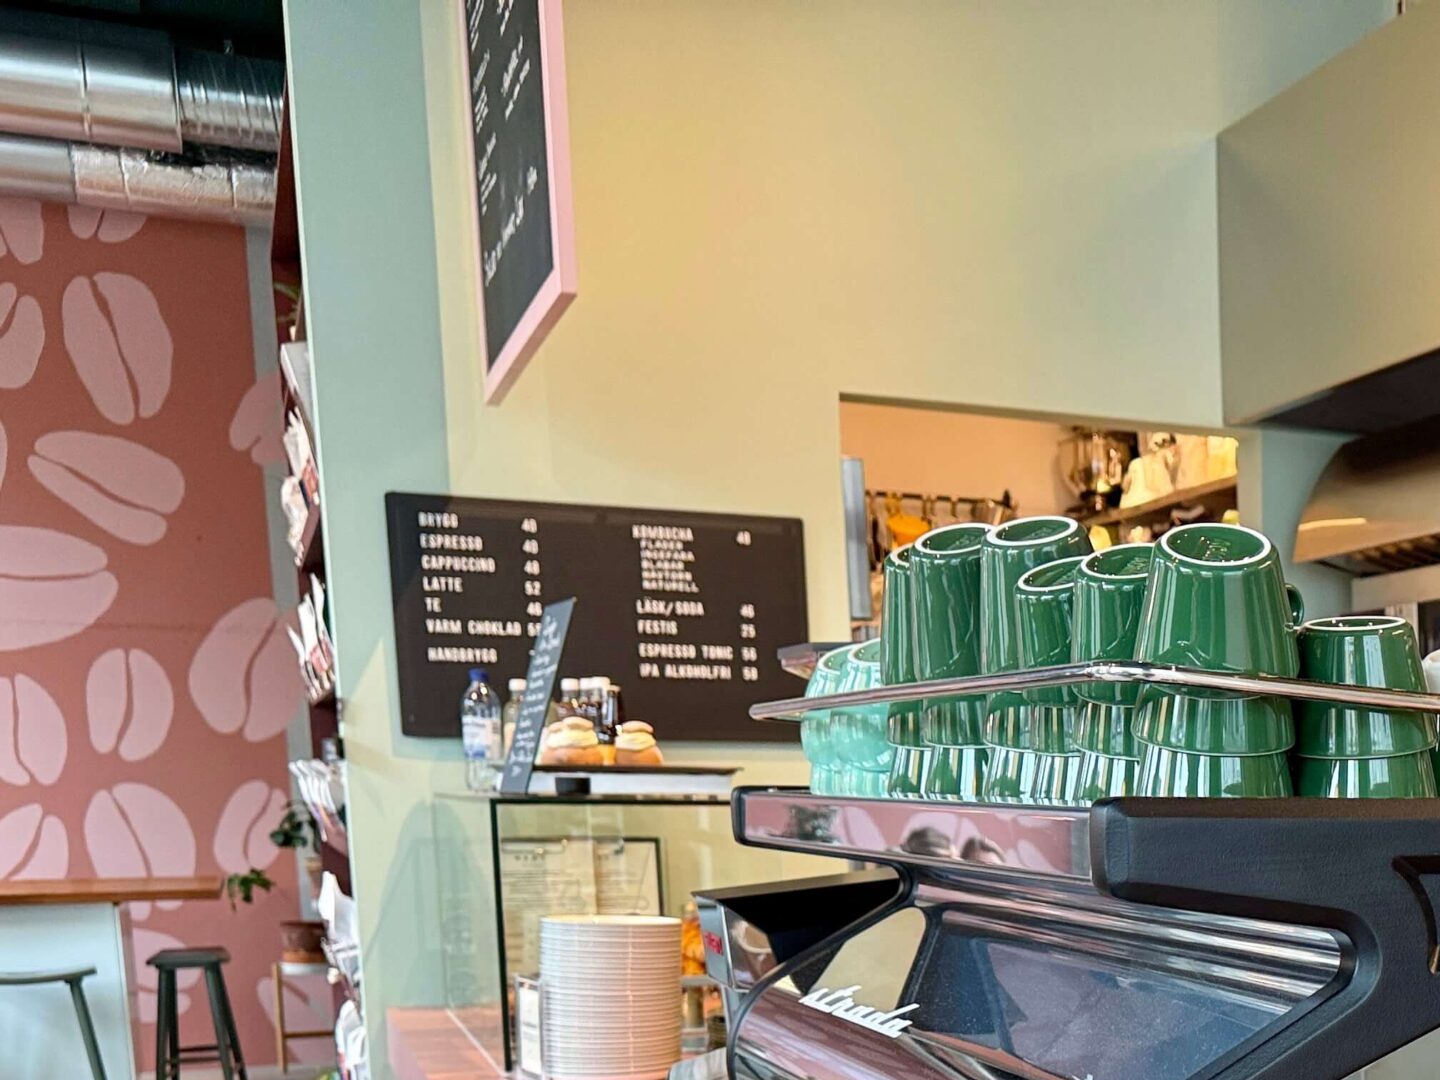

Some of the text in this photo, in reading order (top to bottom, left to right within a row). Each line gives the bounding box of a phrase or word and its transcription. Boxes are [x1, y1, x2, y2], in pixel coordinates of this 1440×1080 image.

[631, 524, 694, 542] KOMBUCHA
[419, 533, 483, 552] ESPRESSO
[421, 554, 496, 573] CAPPUCCINO
[422, 576, 463, 593] LATTE
[424, 596, 442, 613] TE
[426, 618, 462, 634] VARM
[467, 620, 522, 636] CHOKLAD
[637, 619, 678, 636] FESTIS
[638, 642, 697, 659] ESPRESSO
[701, 644, 734, 660] TONIC
[639, 662, 660, 678] IPA
[664, 664, 732, 680] ALKOHOLFRI
